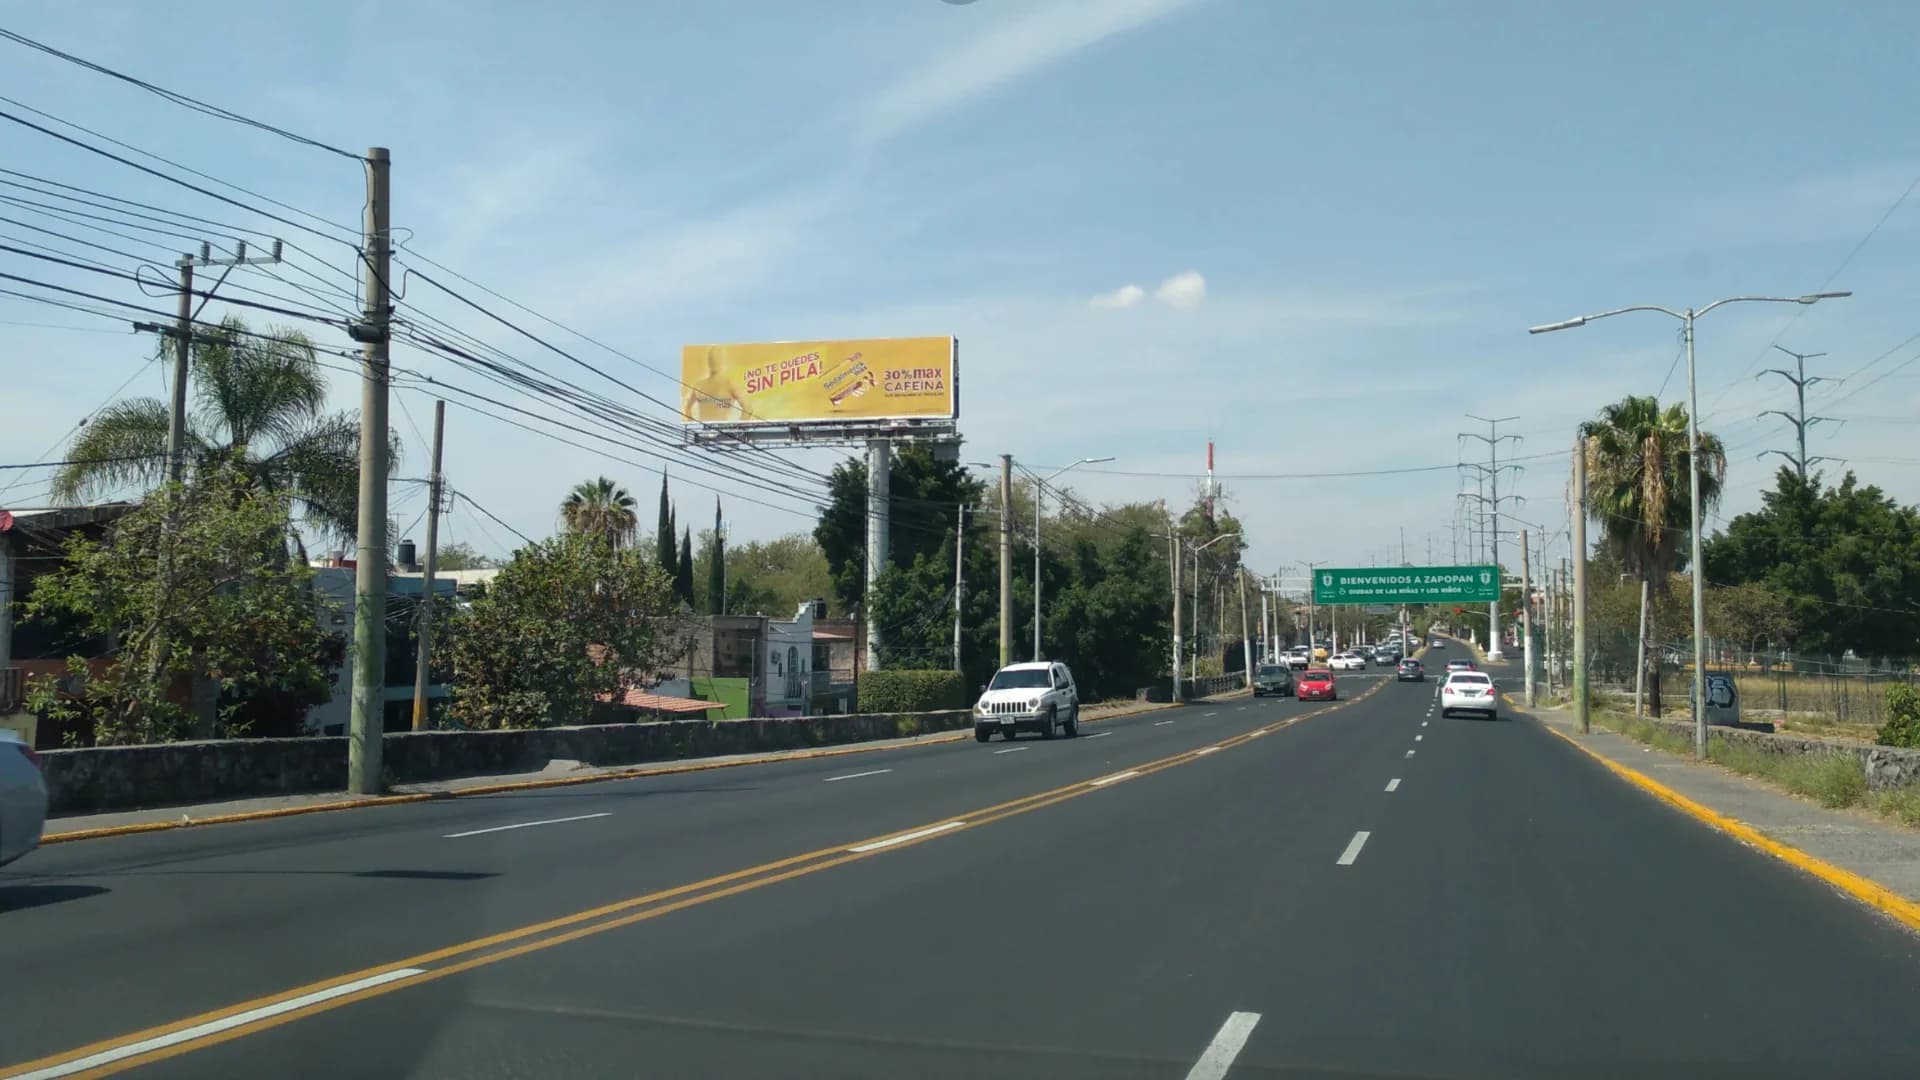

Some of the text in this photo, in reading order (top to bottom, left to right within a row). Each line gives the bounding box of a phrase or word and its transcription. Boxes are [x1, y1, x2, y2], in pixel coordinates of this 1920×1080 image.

[765, 363, 777, 373] TE
[780, 352, 820, 370] QUEDES
[747, 360, 823, 394] SIN PILA!
[1340, 576, 1412, 585] BIENVENIDOS
[1424, 575, 1474, 584] ZAPOPAN
